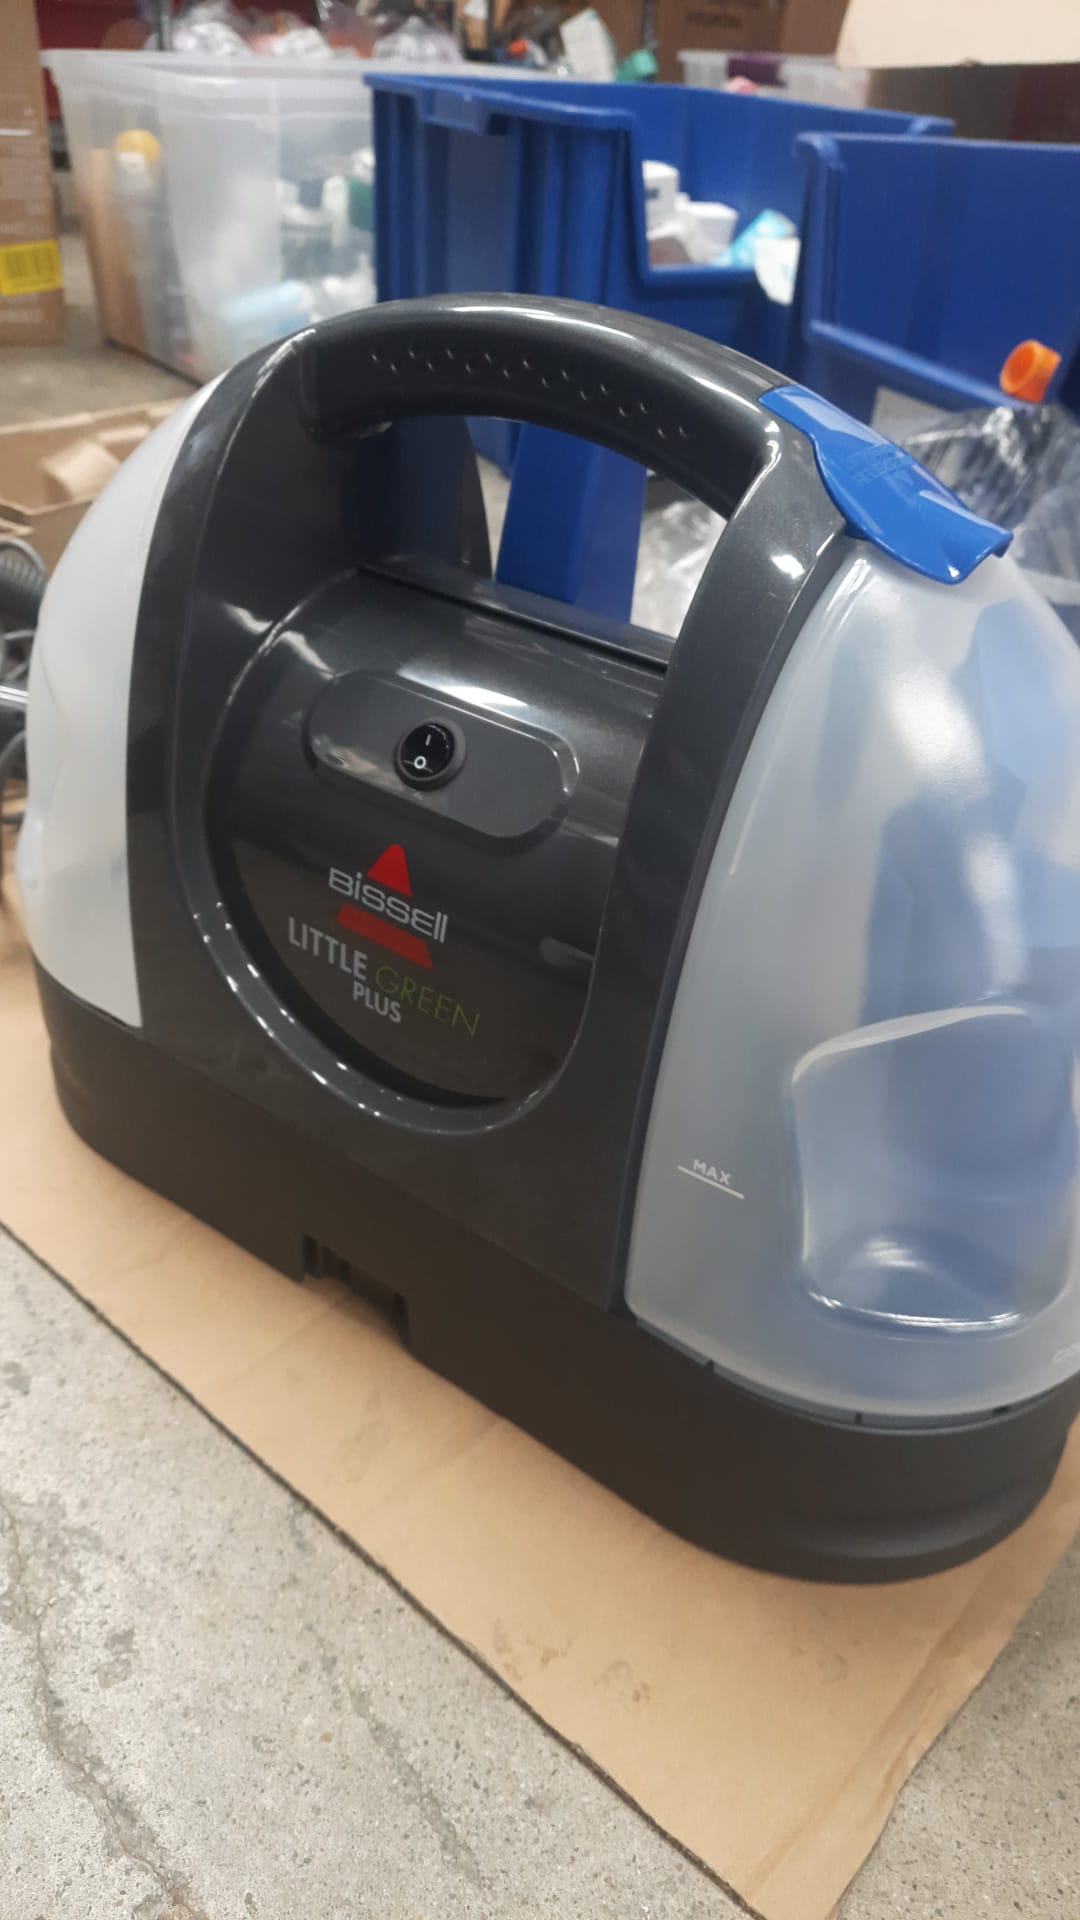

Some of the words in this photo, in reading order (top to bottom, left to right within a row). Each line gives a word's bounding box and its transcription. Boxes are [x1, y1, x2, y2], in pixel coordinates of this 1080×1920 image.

[288, 916, 368, 981] LITTLE
[375, 966, 481, 1038] GREEN
[352, 980, 402, 1024] PLUS
[692, 1159, 732, 1187] MAX
